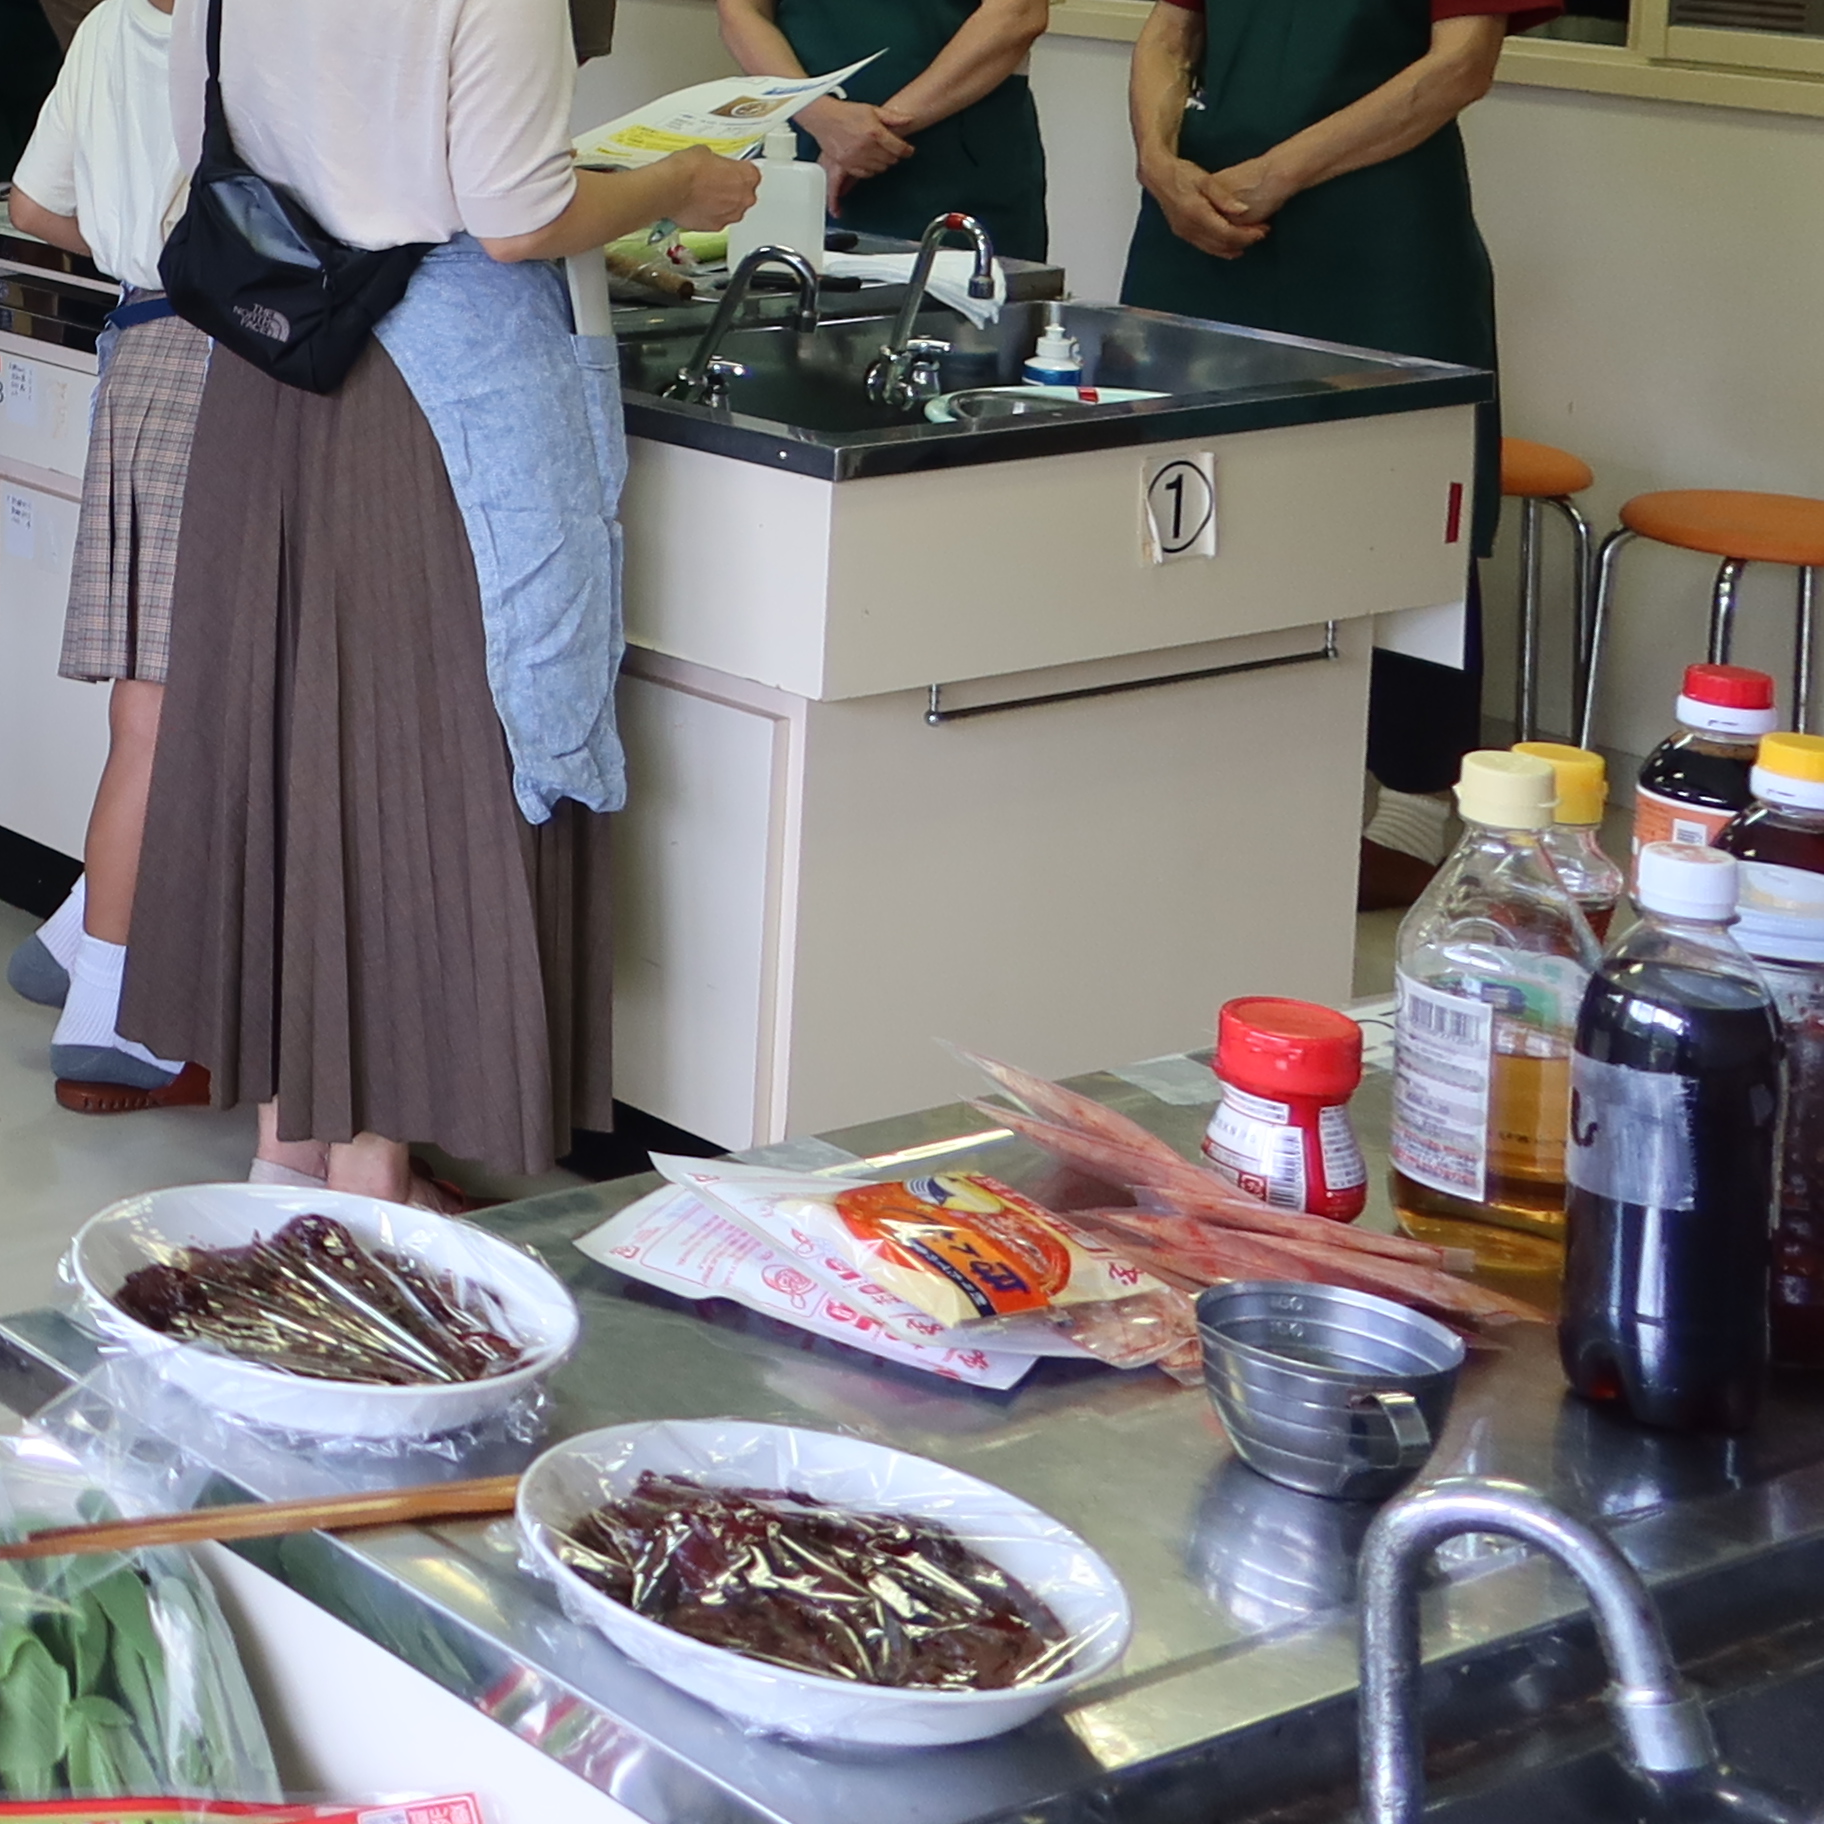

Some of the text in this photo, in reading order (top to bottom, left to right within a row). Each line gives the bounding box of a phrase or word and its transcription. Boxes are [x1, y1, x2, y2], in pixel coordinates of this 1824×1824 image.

[232, 304, 271, 327] NORTH
[253, 302, 271, 317] THE
[240, 315, 268, 335] FACE
